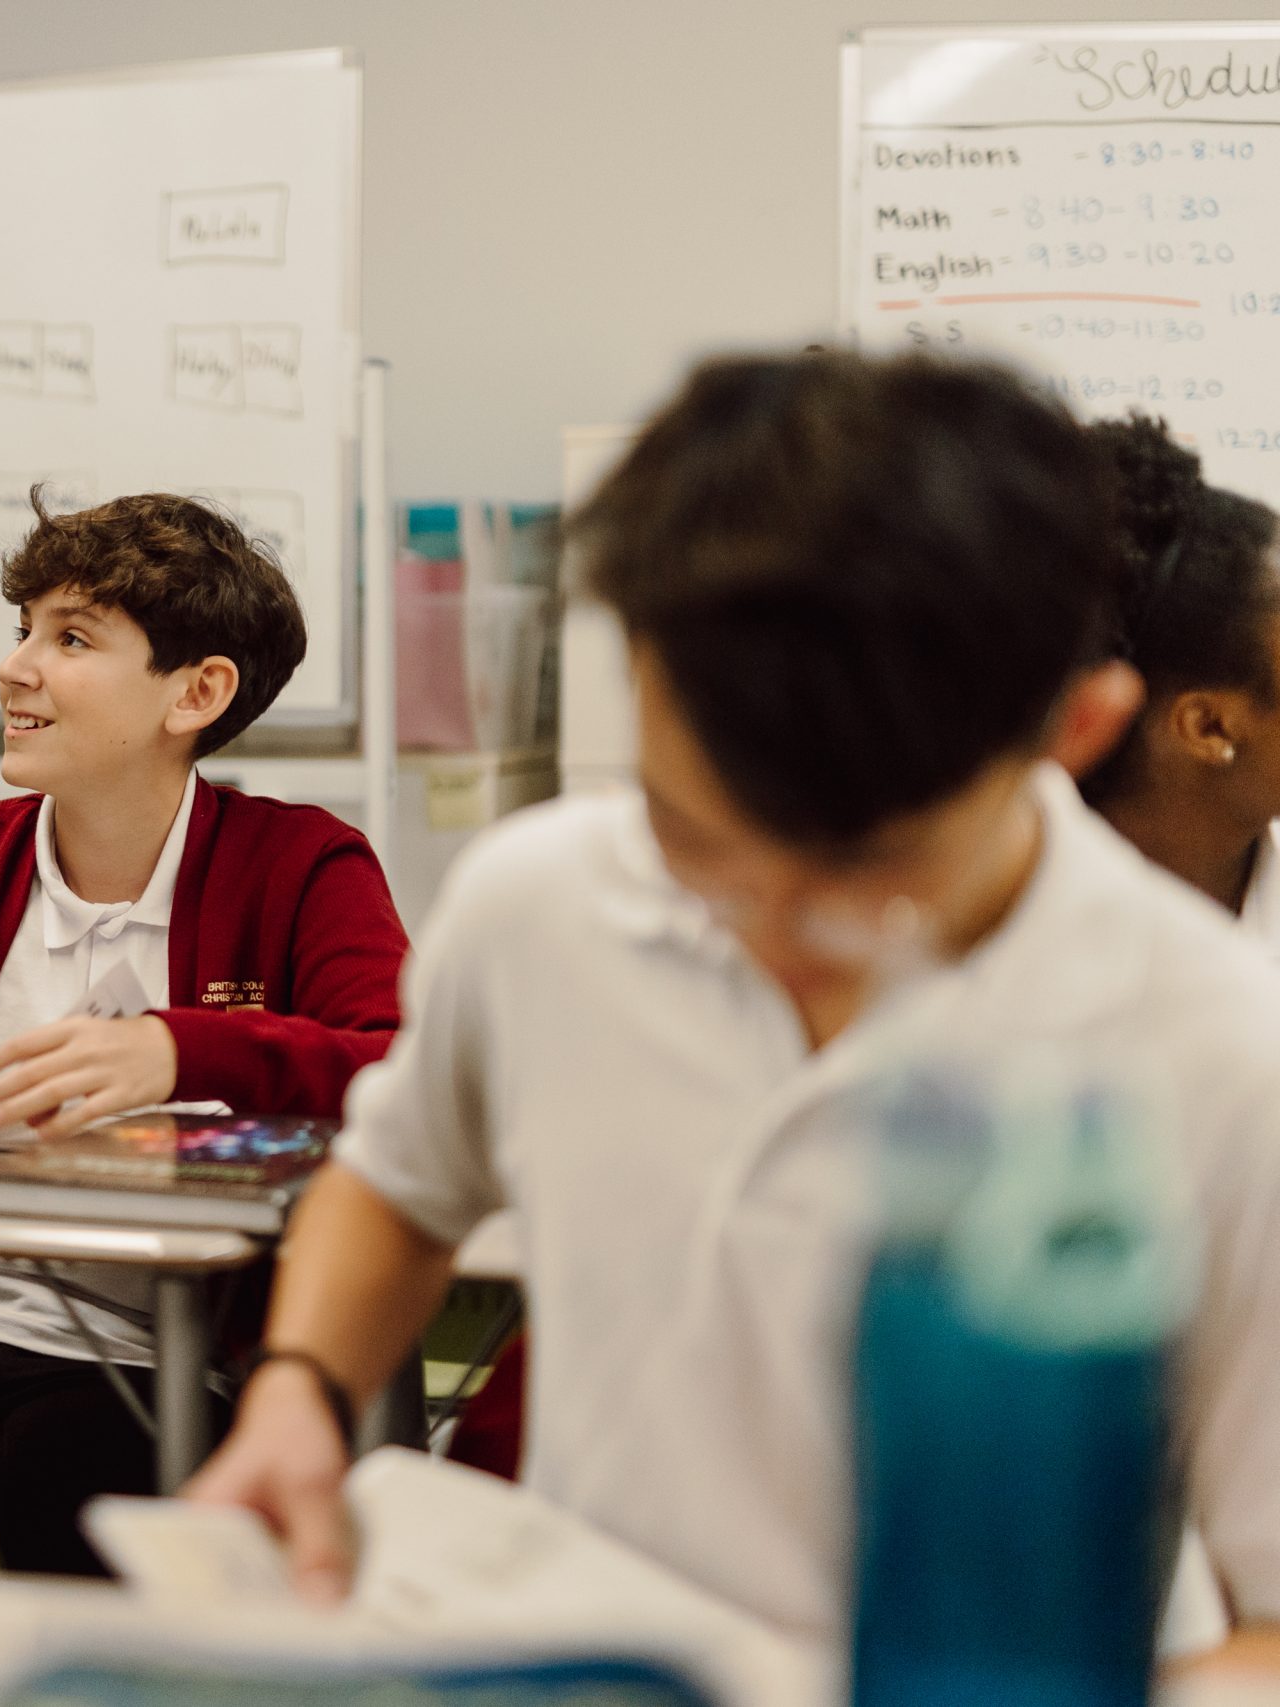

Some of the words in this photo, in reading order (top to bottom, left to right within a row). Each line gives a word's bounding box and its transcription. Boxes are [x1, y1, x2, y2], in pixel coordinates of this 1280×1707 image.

[875, 143, 1021, 169] Devotions
[877, 205, 951, 232] Math
[874, 252, 993, 292] English
